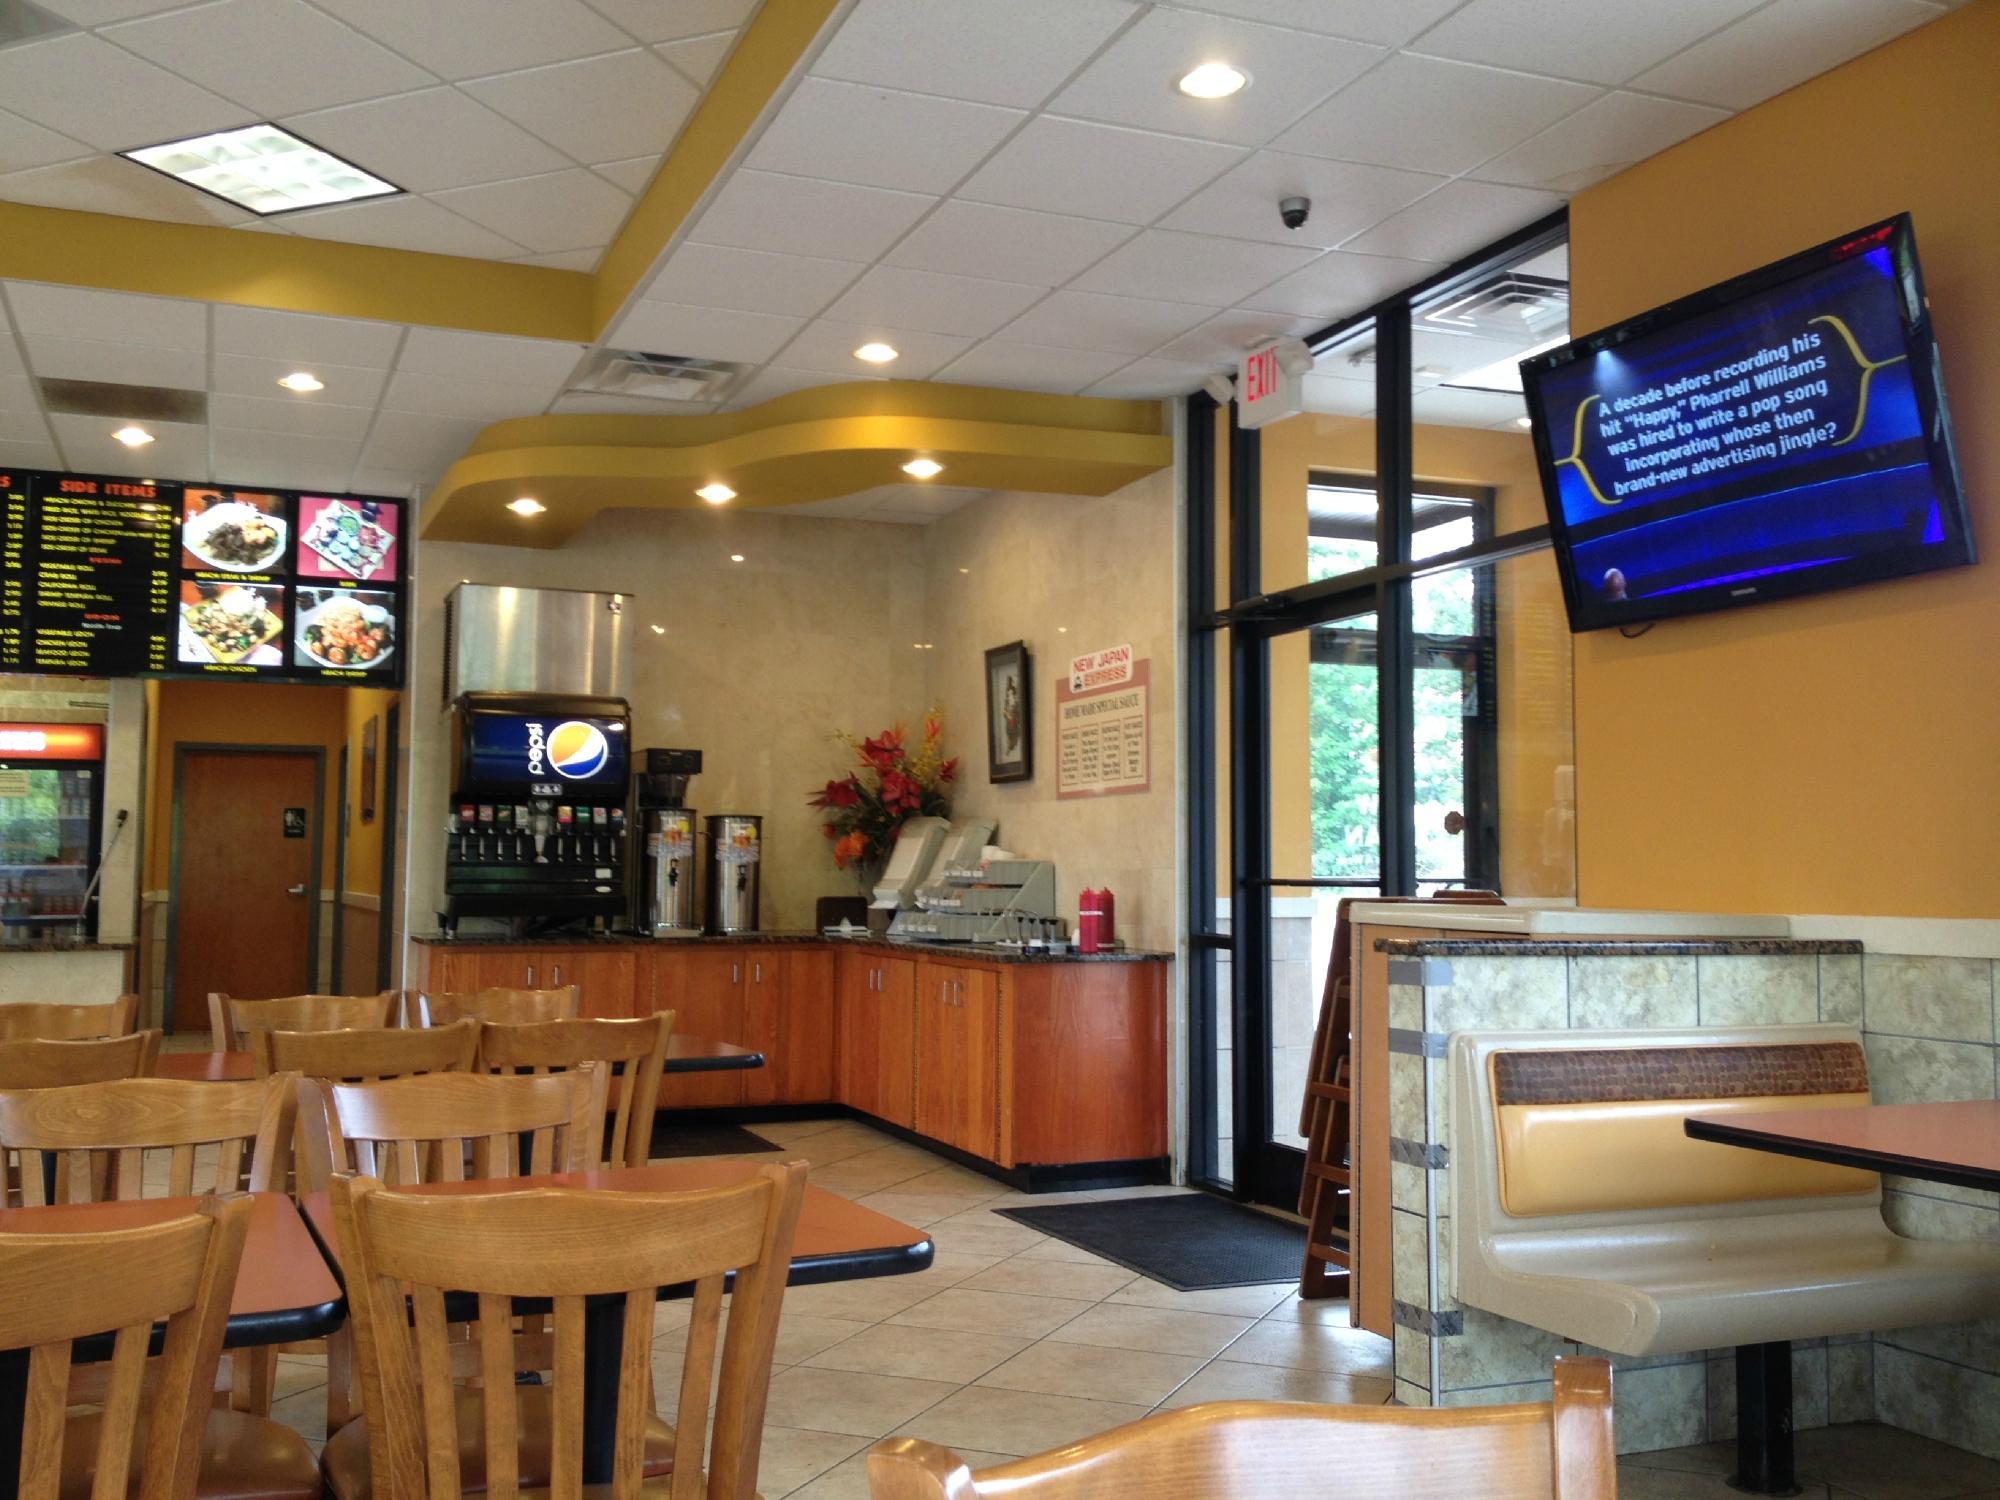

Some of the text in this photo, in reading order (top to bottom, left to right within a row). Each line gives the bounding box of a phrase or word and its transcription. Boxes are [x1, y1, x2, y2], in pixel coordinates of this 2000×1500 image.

[1246, 347, 1279, 404] EXIT
[1599, 333, 1821, 417] A decade before recording his
[1600, 419, 1623, 438] hit
[1690, 378, 1750, 411] Pharrell
[1753, 355, 1827, 390] Williams
[1608, 379, 1828, 456] was hired to write a pop song
[1625, 408, 1815, 472] incorporating whose then
[59, 480, 156, 498] SIDE ITEMS
[1614, 422, 1837, 496] brand-new advertising jingle?
[1073, 647, 1129, 673] NEW JAPAN
[526, 722, 546, 776] pepsi
